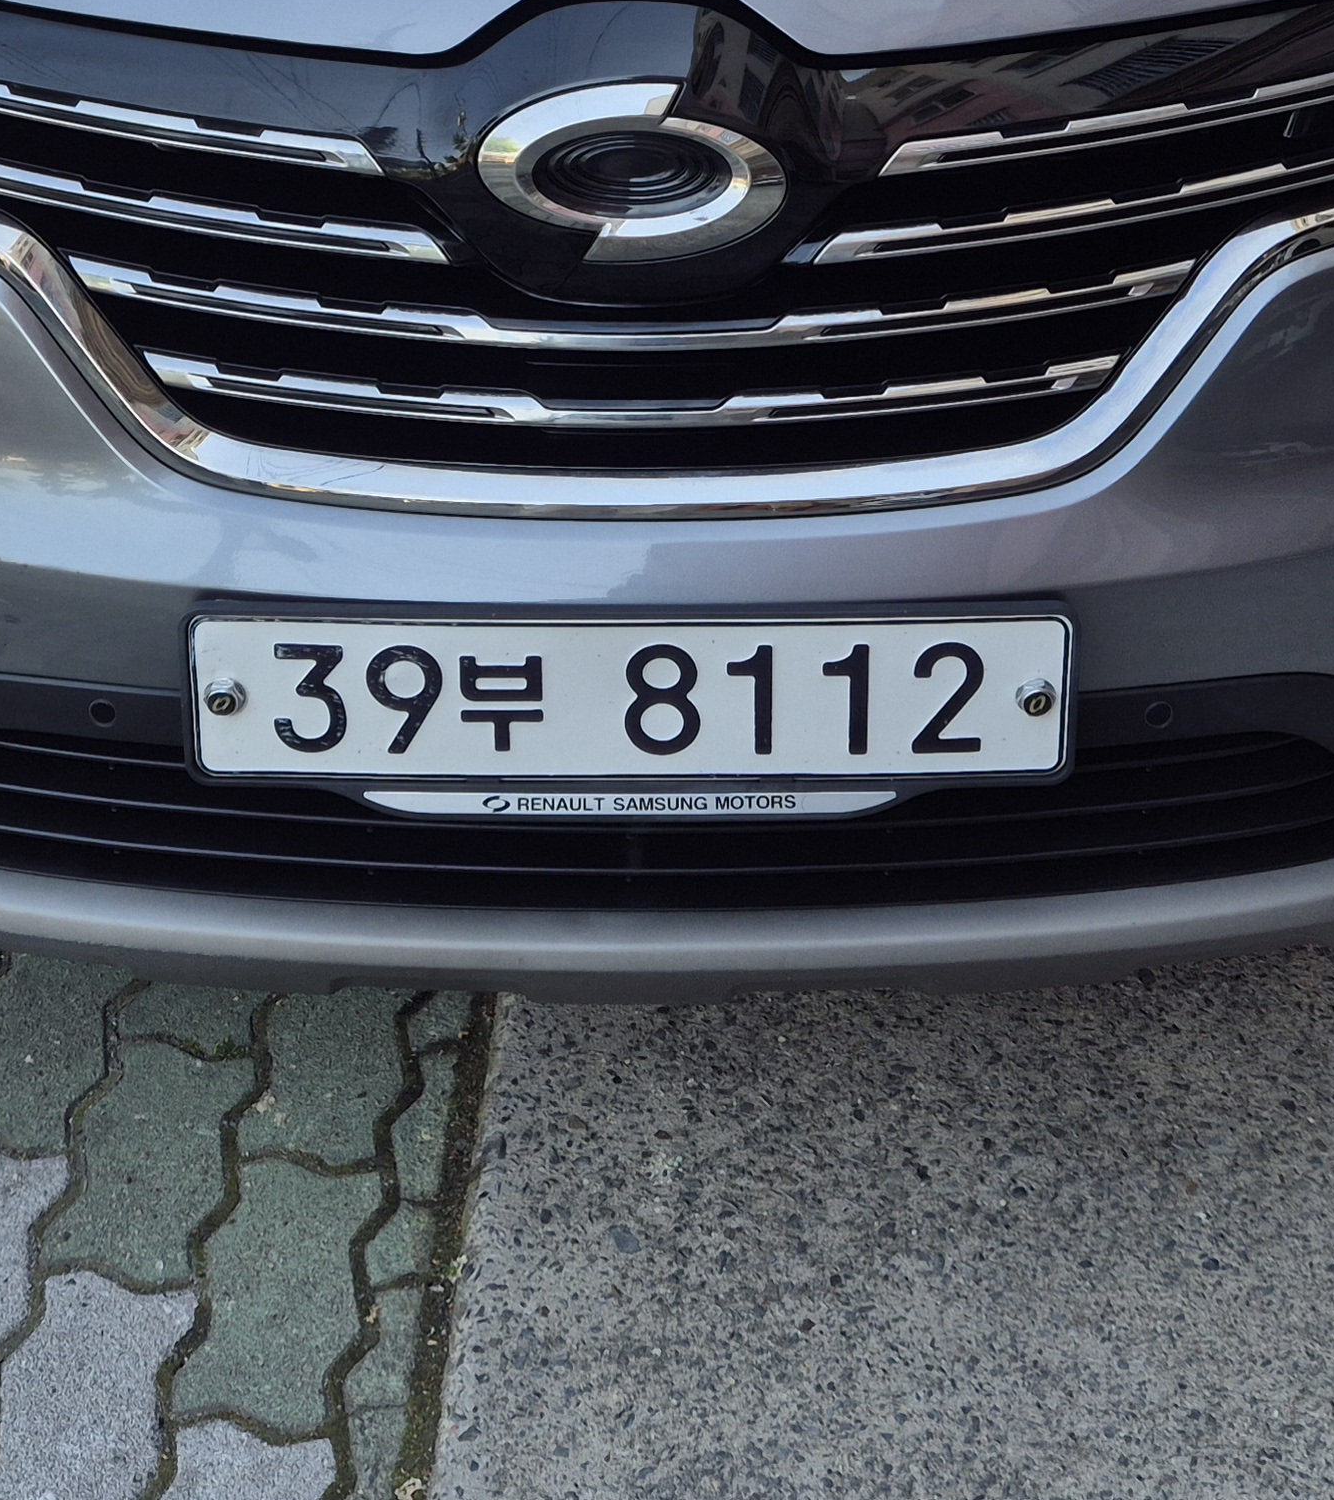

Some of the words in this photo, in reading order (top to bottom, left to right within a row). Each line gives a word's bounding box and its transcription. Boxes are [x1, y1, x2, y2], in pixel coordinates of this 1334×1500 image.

[273, 642, 544, 755] 39부
[624, 642, 985, 756] 8112
[517, 797, 605, 812] RENAULT
[613, 796, 708, 812] SAMSUNG
[715, 794, 797, 811] MOTORS
